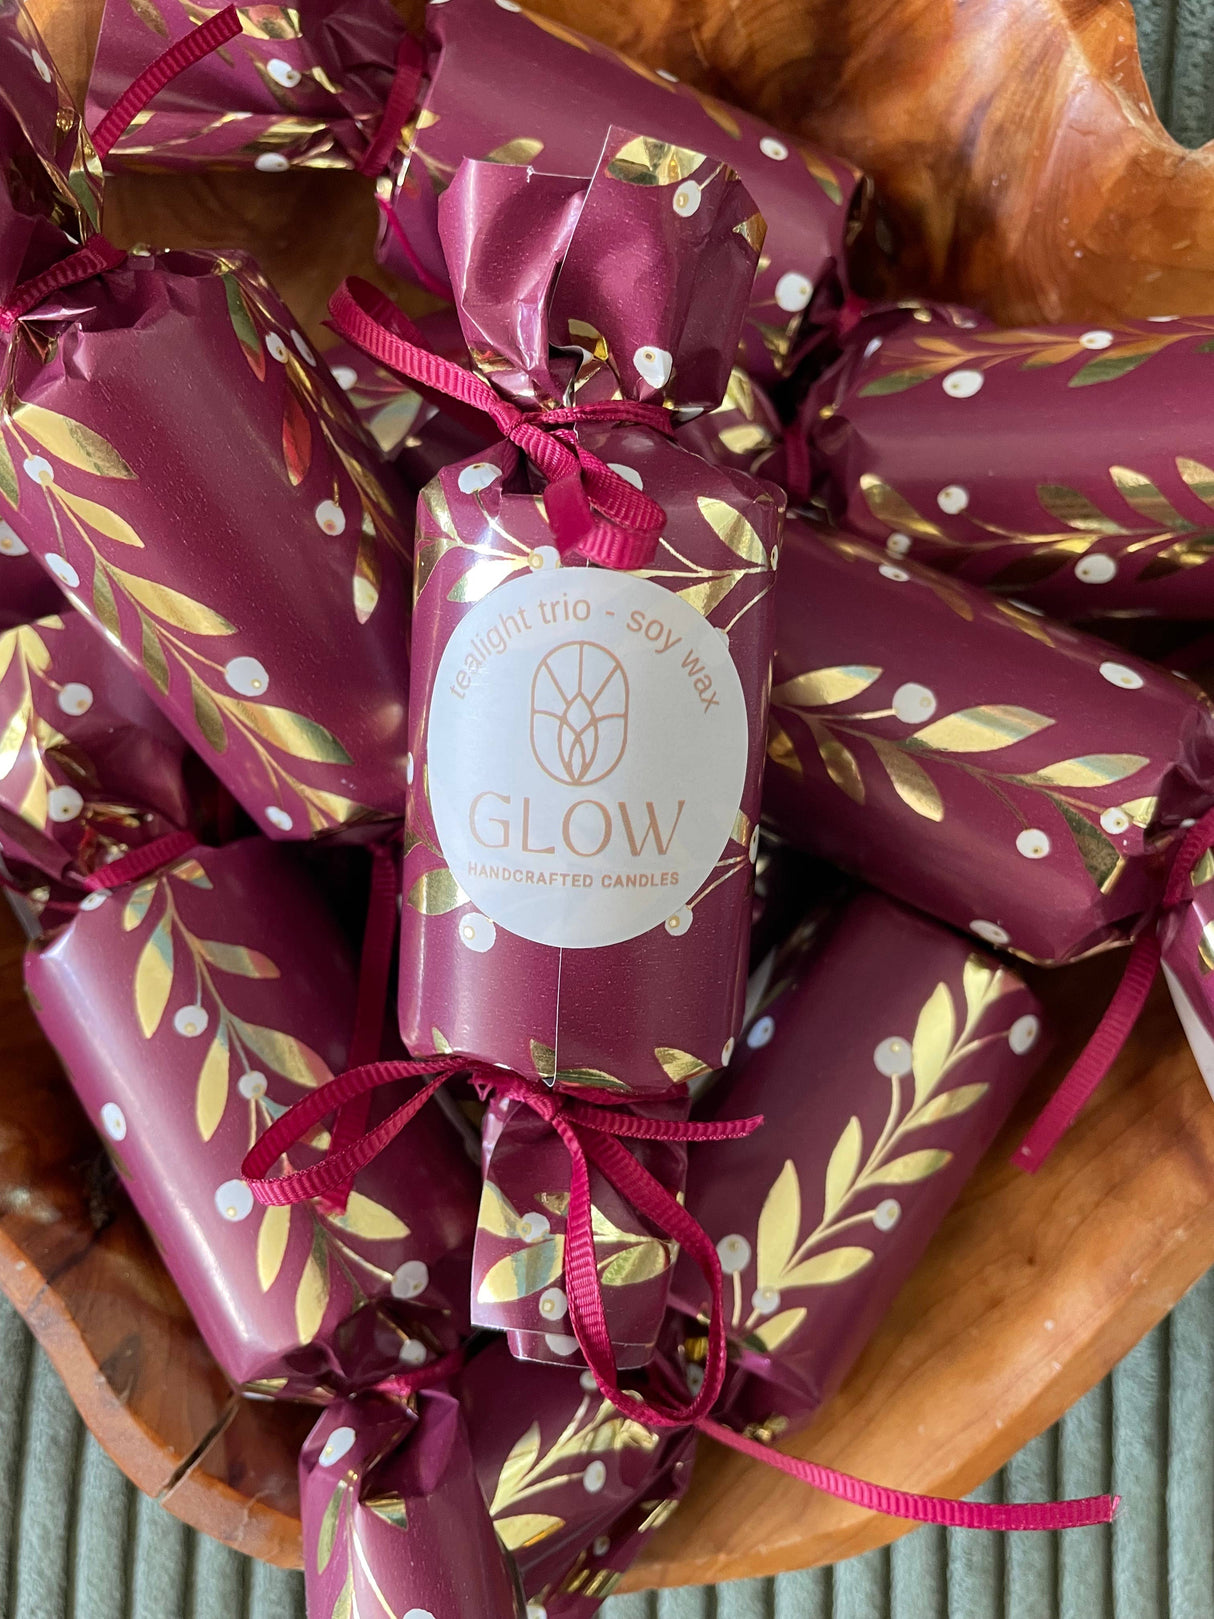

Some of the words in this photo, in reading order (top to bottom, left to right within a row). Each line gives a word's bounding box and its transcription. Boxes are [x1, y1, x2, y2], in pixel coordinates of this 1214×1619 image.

[449, 606, 532, 700] tealight
[539, 592, 591, 625] trio
[627, 610, 682, 654] soy
[681, 649, 720, 714] wax
[469, 791, 686, 858] GLOW
[468, 861, 593, 888] HANDCRAFTED
[601, 871, 680, 888] CANDLES
